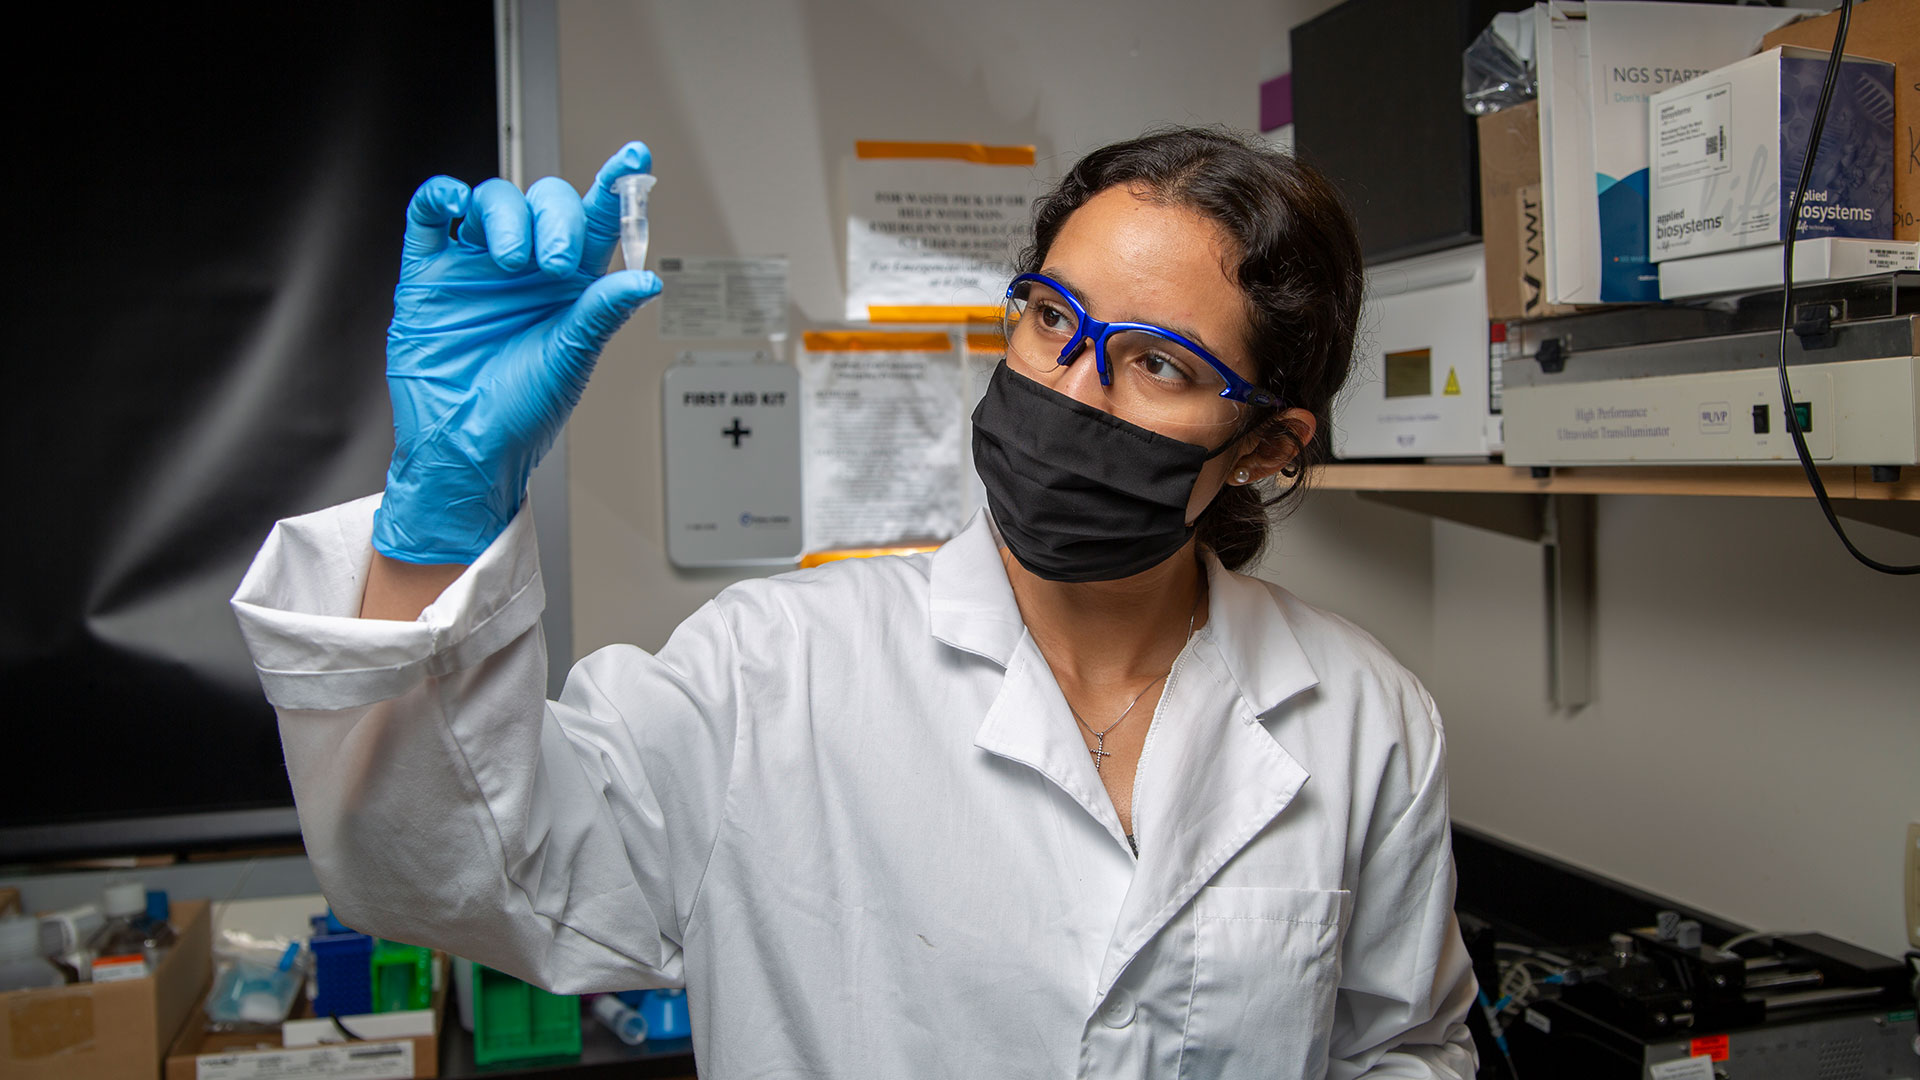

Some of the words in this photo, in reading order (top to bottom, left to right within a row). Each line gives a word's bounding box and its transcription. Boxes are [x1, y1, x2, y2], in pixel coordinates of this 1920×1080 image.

[1613, 66, 1650, 83] NGS
[1654, 68, 1709, 84] START
[1790, 189, 1828, 203] aplied
[1657, 208, 1685, 226] applied
[1656, 215, 1722, 240] biosystems
[683, 391, 726, 407] FIRST
[731, 391, 757, 407] AID
[760, 391, 787, 407] KIT
[1575, 407, 1596, 423] High
[1597, 406, 1649, 421] Performance
[1557, 427, 1600, 441] Ultraviolet
[1601, 424, 1671, 439] Transilluminator
